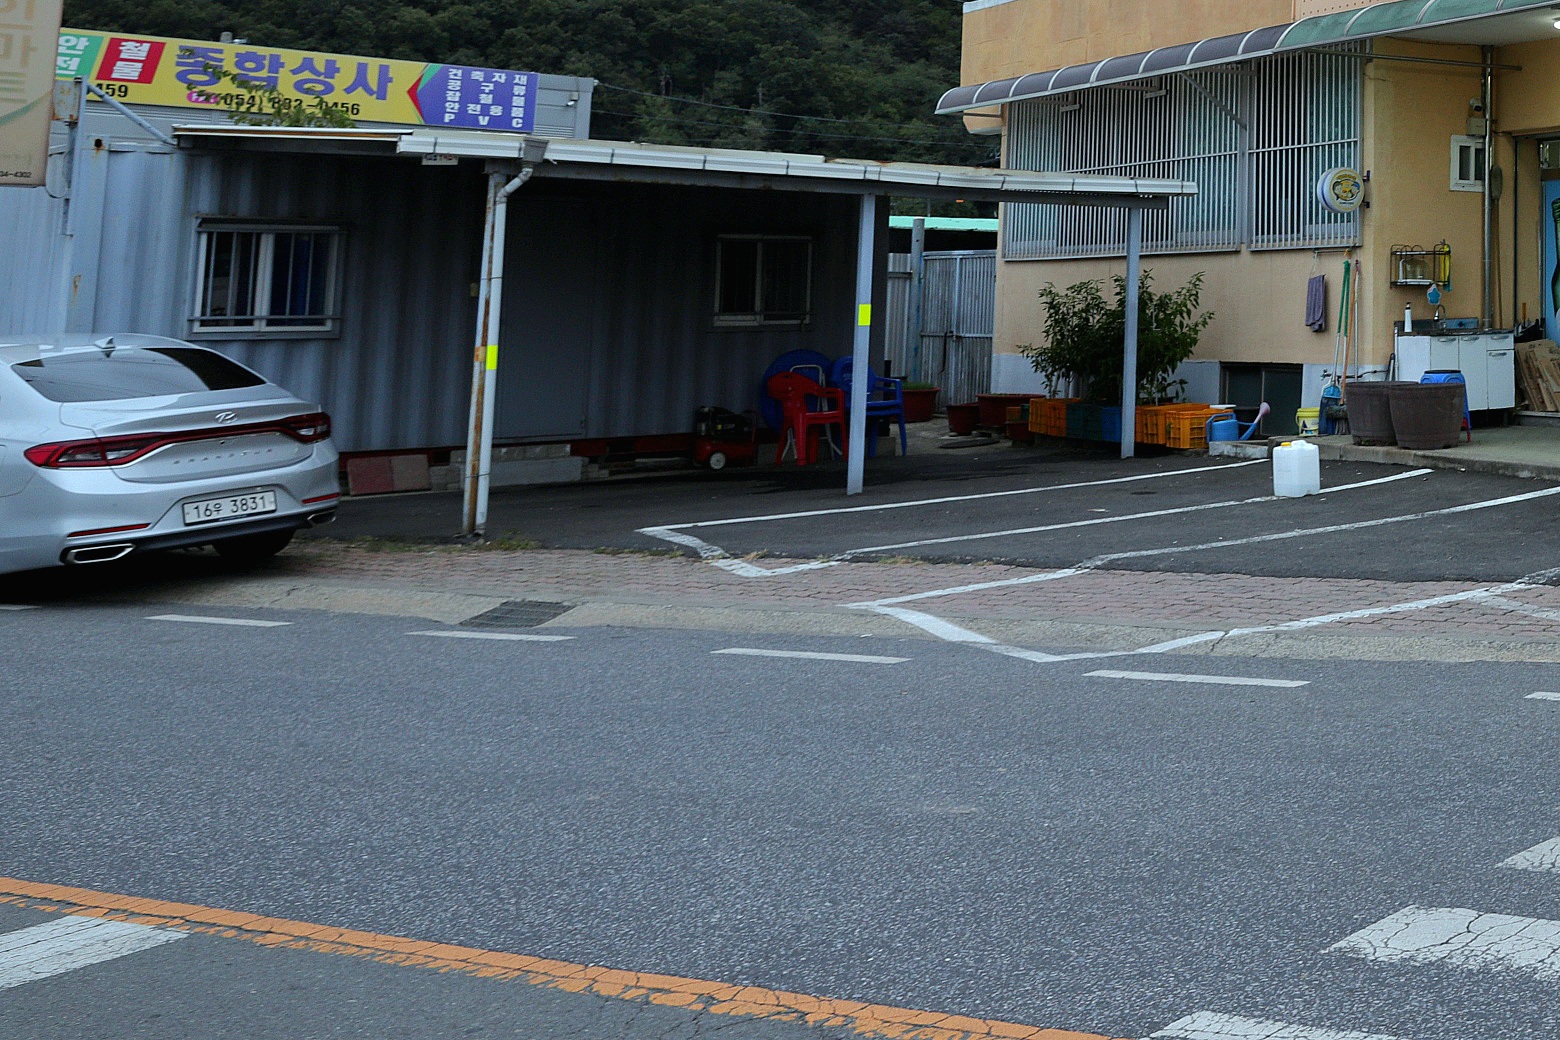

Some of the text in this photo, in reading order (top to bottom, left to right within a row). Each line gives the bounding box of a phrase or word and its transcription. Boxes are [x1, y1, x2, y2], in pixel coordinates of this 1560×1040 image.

[110, 41, 150, 80] 철물
[175, 44, 394, 101] 종합상사
[443, 112, 523, 128] PVC
[193, 496, 267, 519] 16우 3831
